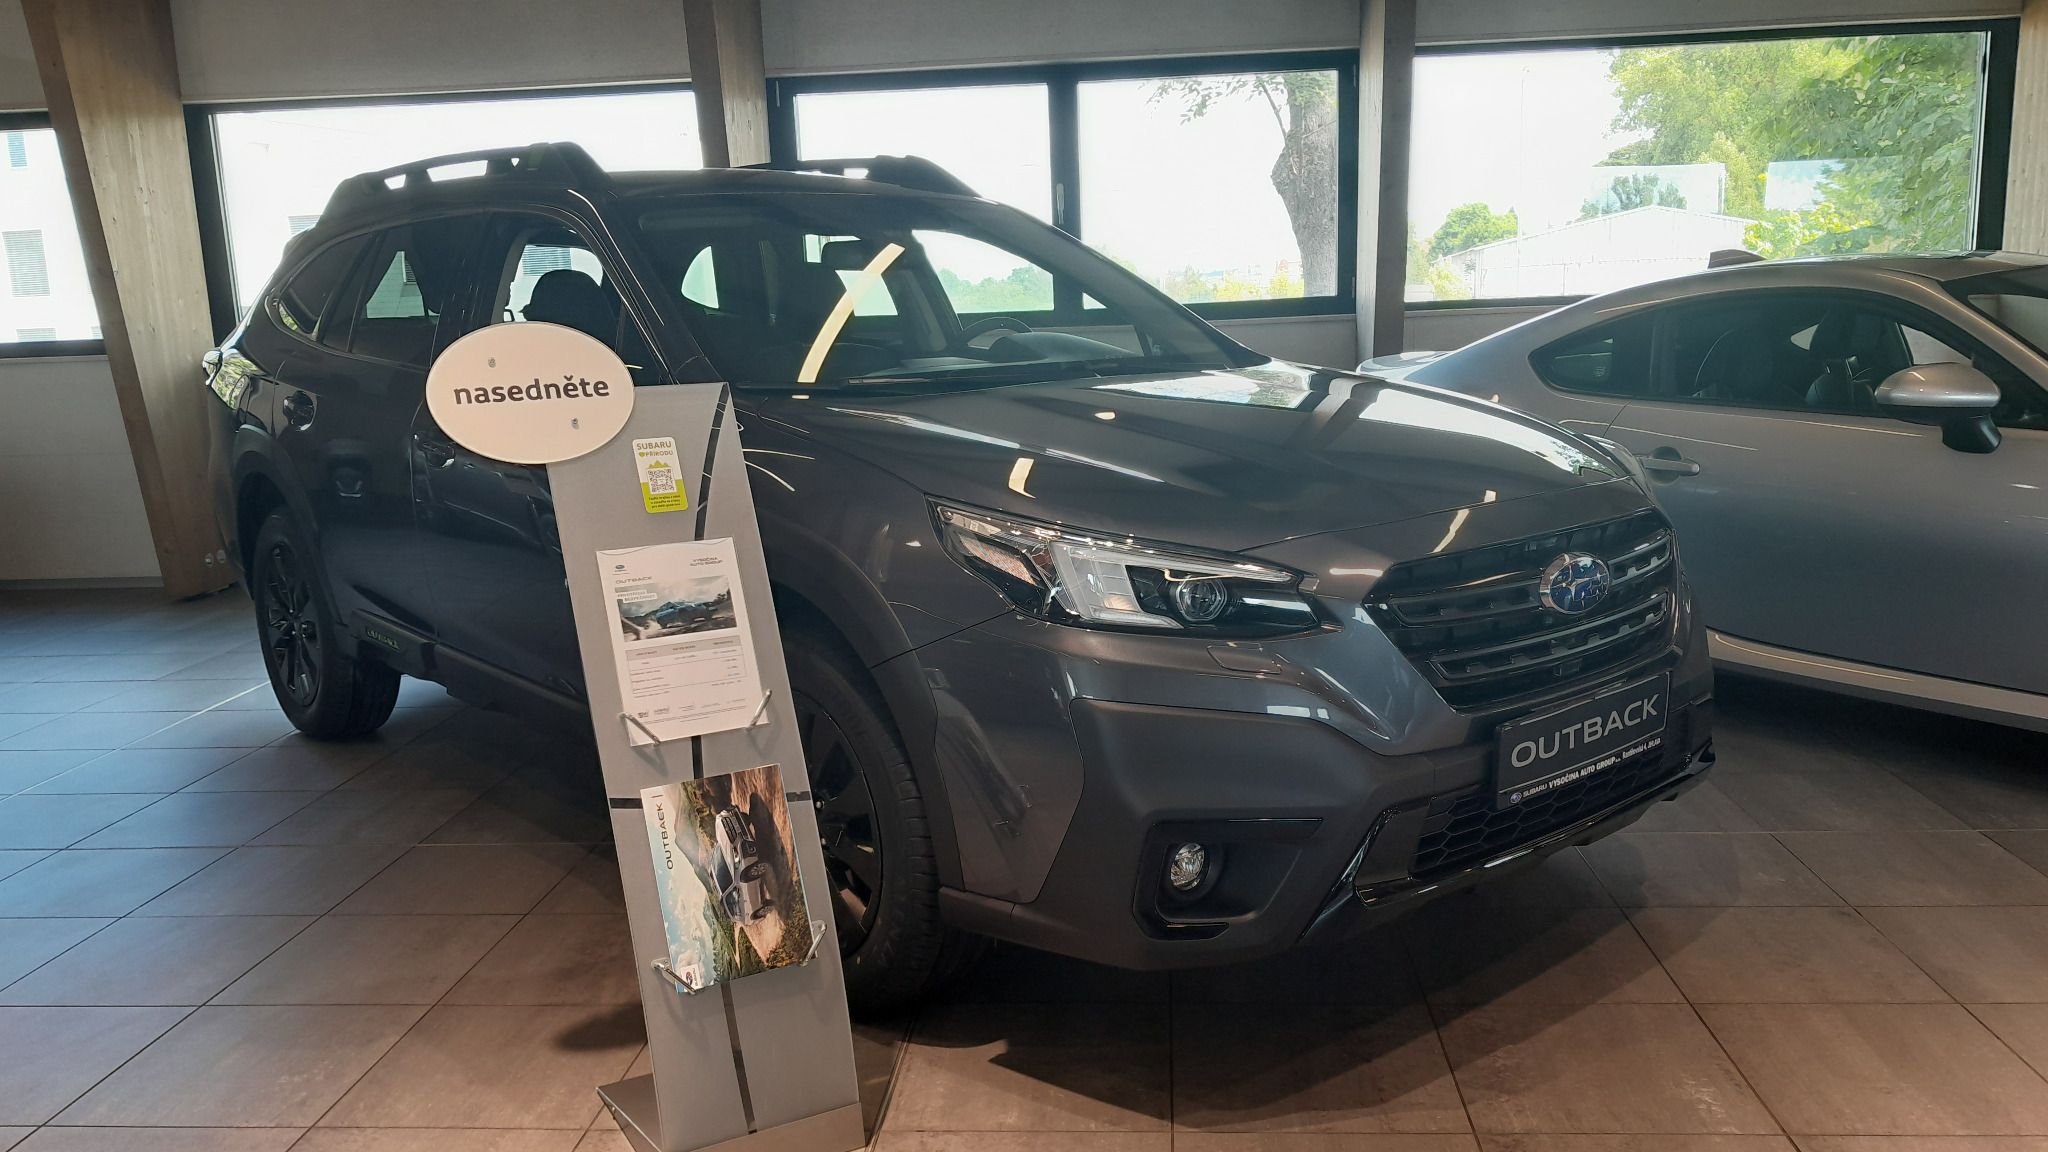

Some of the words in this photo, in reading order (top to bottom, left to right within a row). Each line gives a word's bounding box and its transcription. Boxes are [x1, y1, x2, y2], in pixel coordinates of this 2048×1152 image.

[453, 375, 610, 405] nasedněte
[636, 441, 672, 451] SUBARU
[1510, 693, 1660, 768] OUTBACK
[1548, 770, 1580, 789] VYSOČINA
[1580, 764, 1596, 777] AUTO
[1596, 756, 1616, 771] GROUP
[655, 802, 674, 870] OUTBACK
